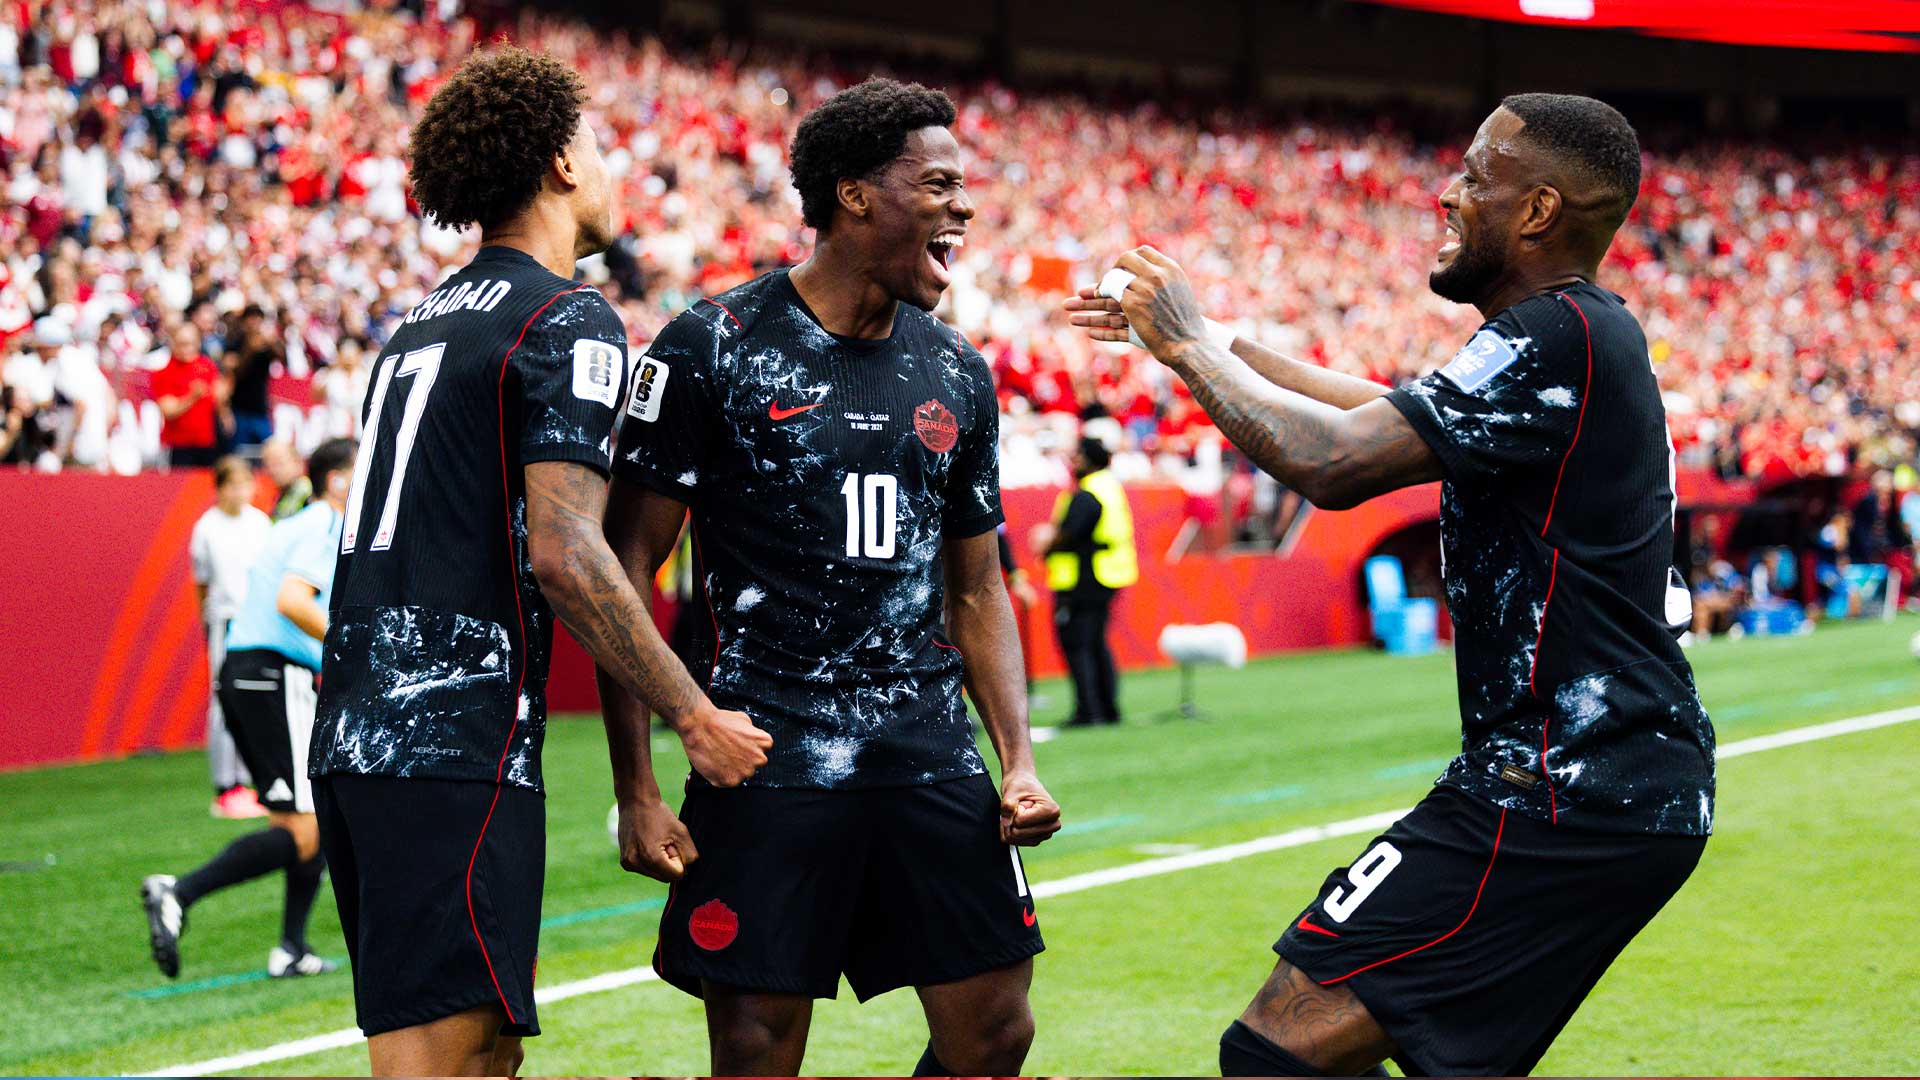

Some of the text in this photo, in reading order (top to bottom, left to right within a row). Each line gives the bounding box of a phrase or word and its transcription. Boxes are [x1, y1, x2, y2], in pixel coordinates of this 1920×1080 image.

[341, 342, 447, 555] 17
[917, 420, 956, 435] CANADA
[840, 472, 897, 559] 10
[410, 746, 463, 757] AERO-FIT
[1323, 841, 1403, 924] 9
[691, 919, 734, 932] CANADA
